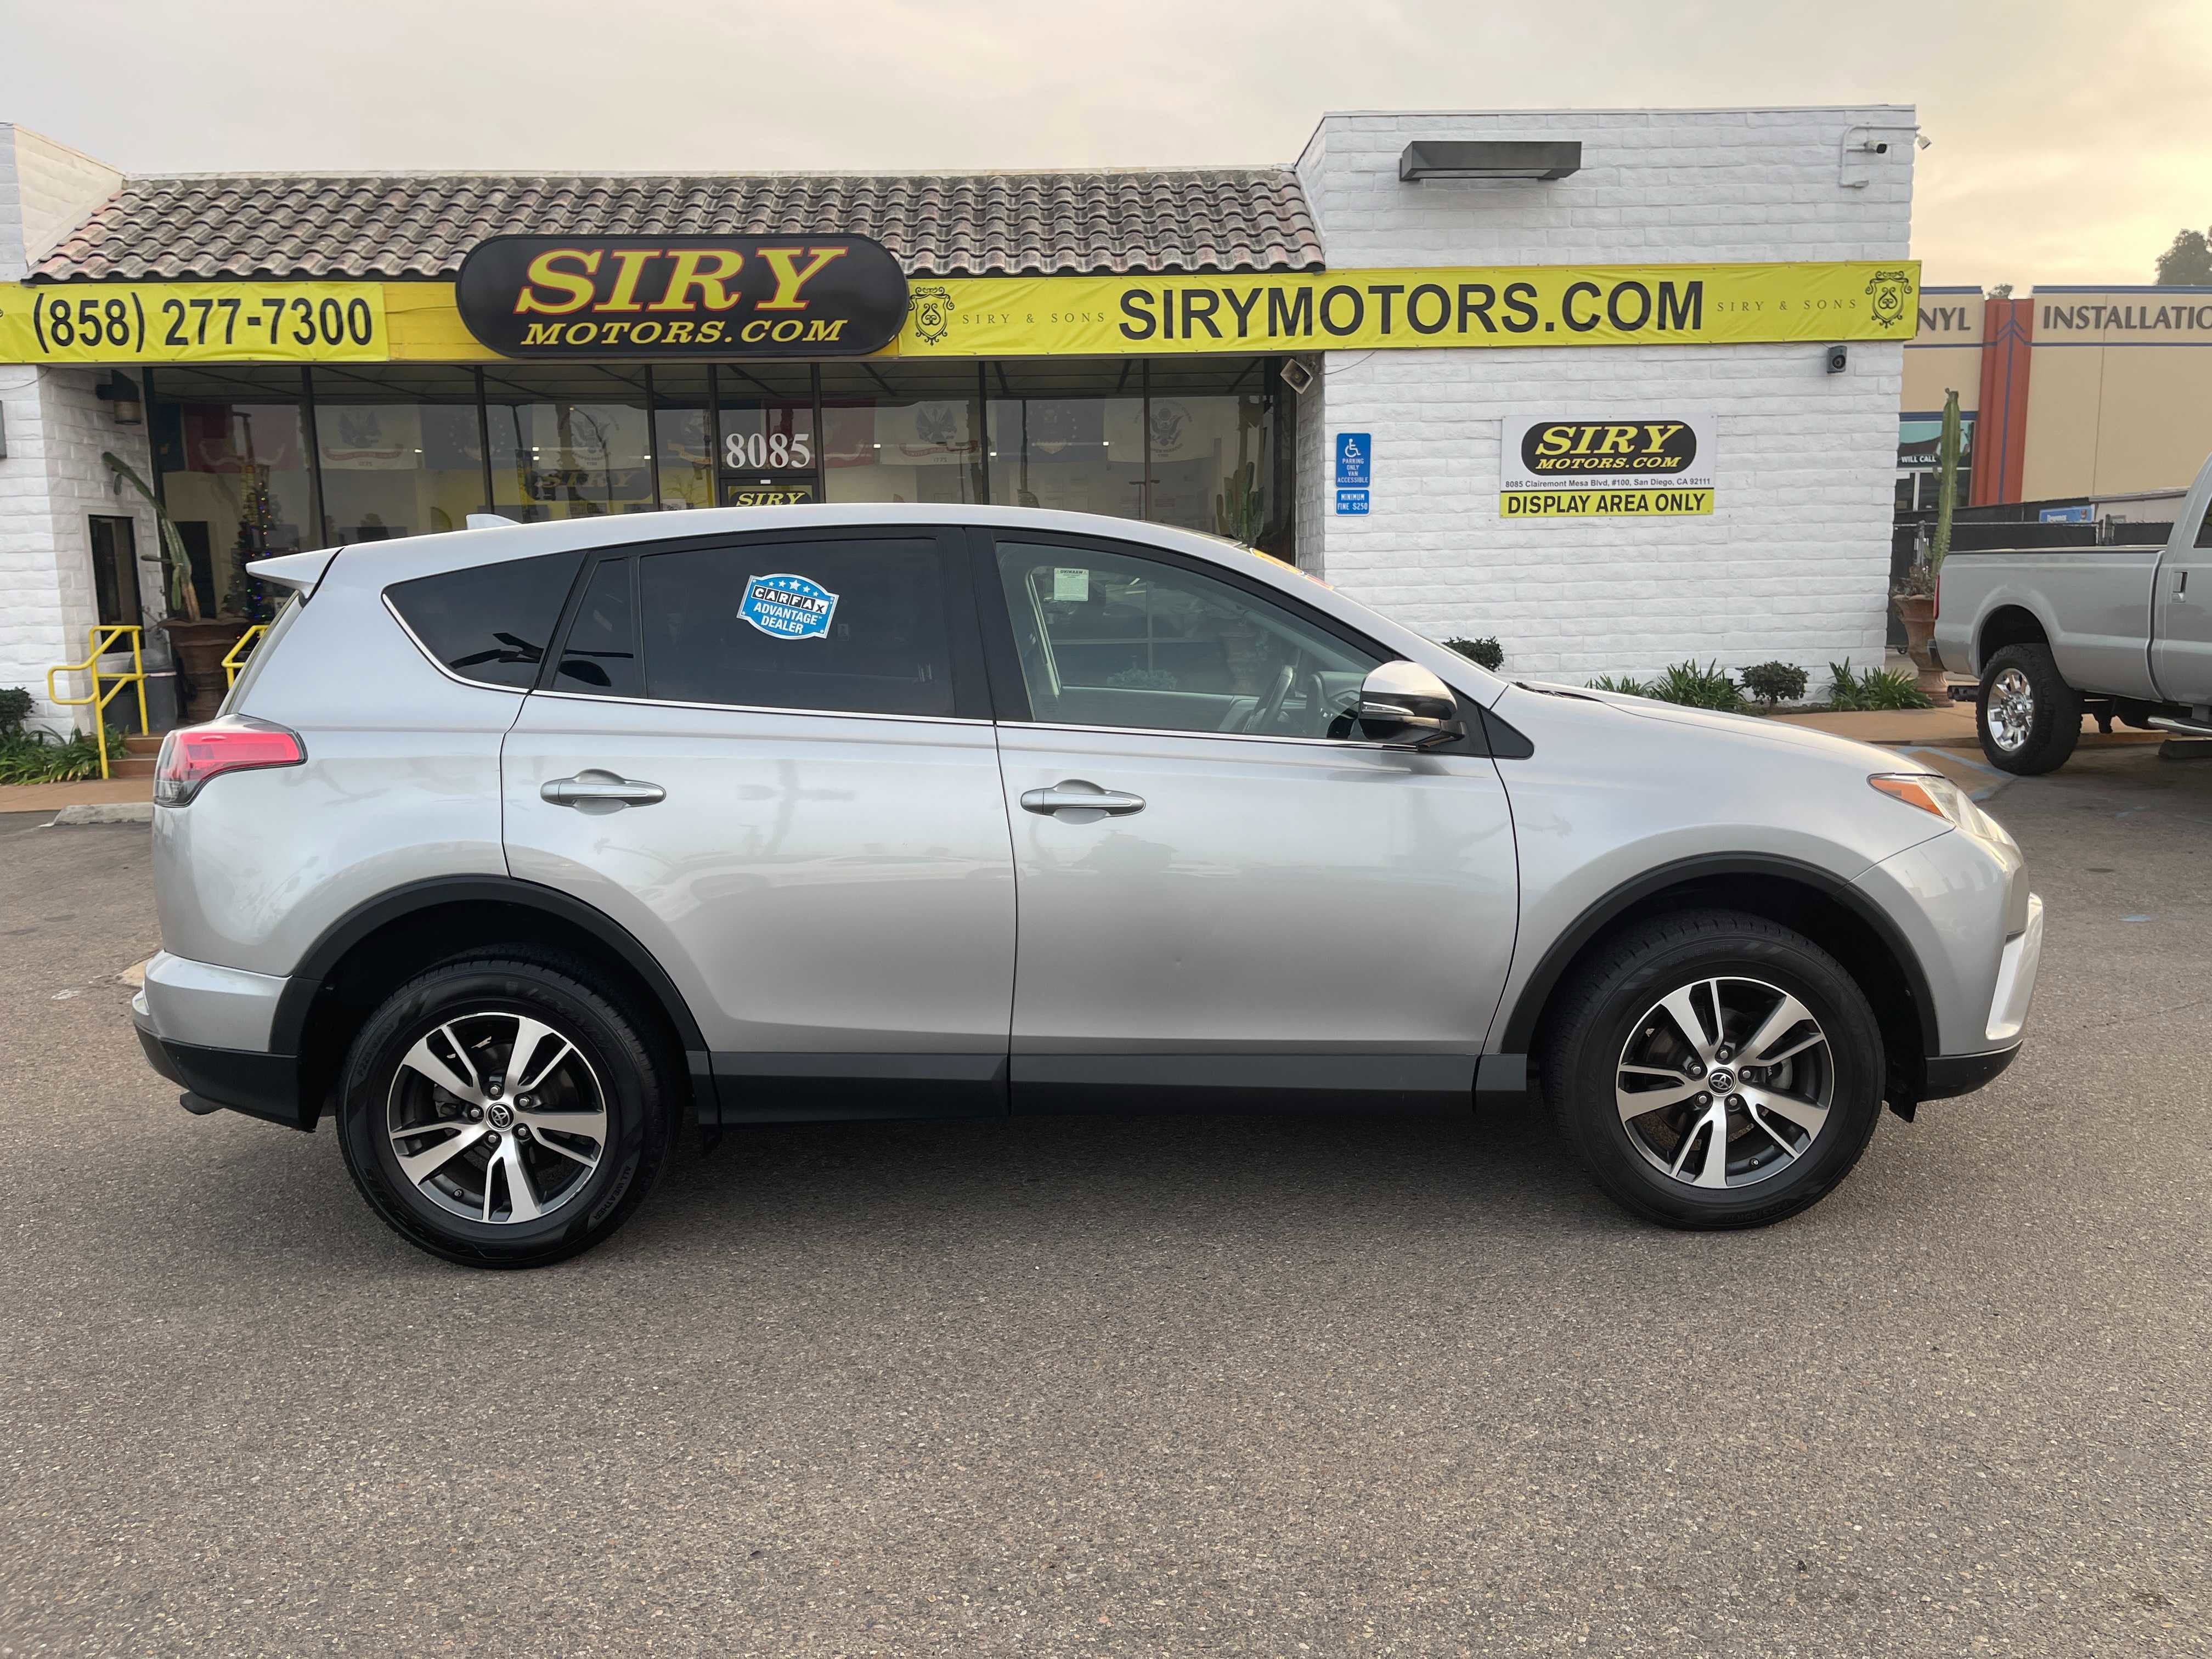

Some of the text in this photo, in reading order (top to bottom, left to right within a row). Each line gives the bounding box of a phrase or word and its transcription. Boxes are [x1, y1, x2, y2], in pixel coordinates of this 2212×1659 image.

[513, 246, 848, 314] SIRY
[1119, 280, 1703, 341] SIRYMOTORS.COM
[1717, 299, 1856, 312] SIRY & SONS
[33, 292, 373, 353] (858) 277-7300
[962, 313, 1104, 324] SIRY & SONS
[520, 320, 848, 346] MOTORS.COM
[726, 433, 810, 468] 8085
[1535, 425, 1684, 455] SIRY
[1535, 456, 1681, 470] MOTORS.COM
[1651, 478, 1674, 487] Diego,
[736, 492, 805, 506] SIRY
[1352, 502, 1368, 510] $250
[1508, 493, 1705, 514] DISPLAY AREA ONLY
[754, 587, 826, 614] CARFAX
[760, 615, 804, 634] DEALER
